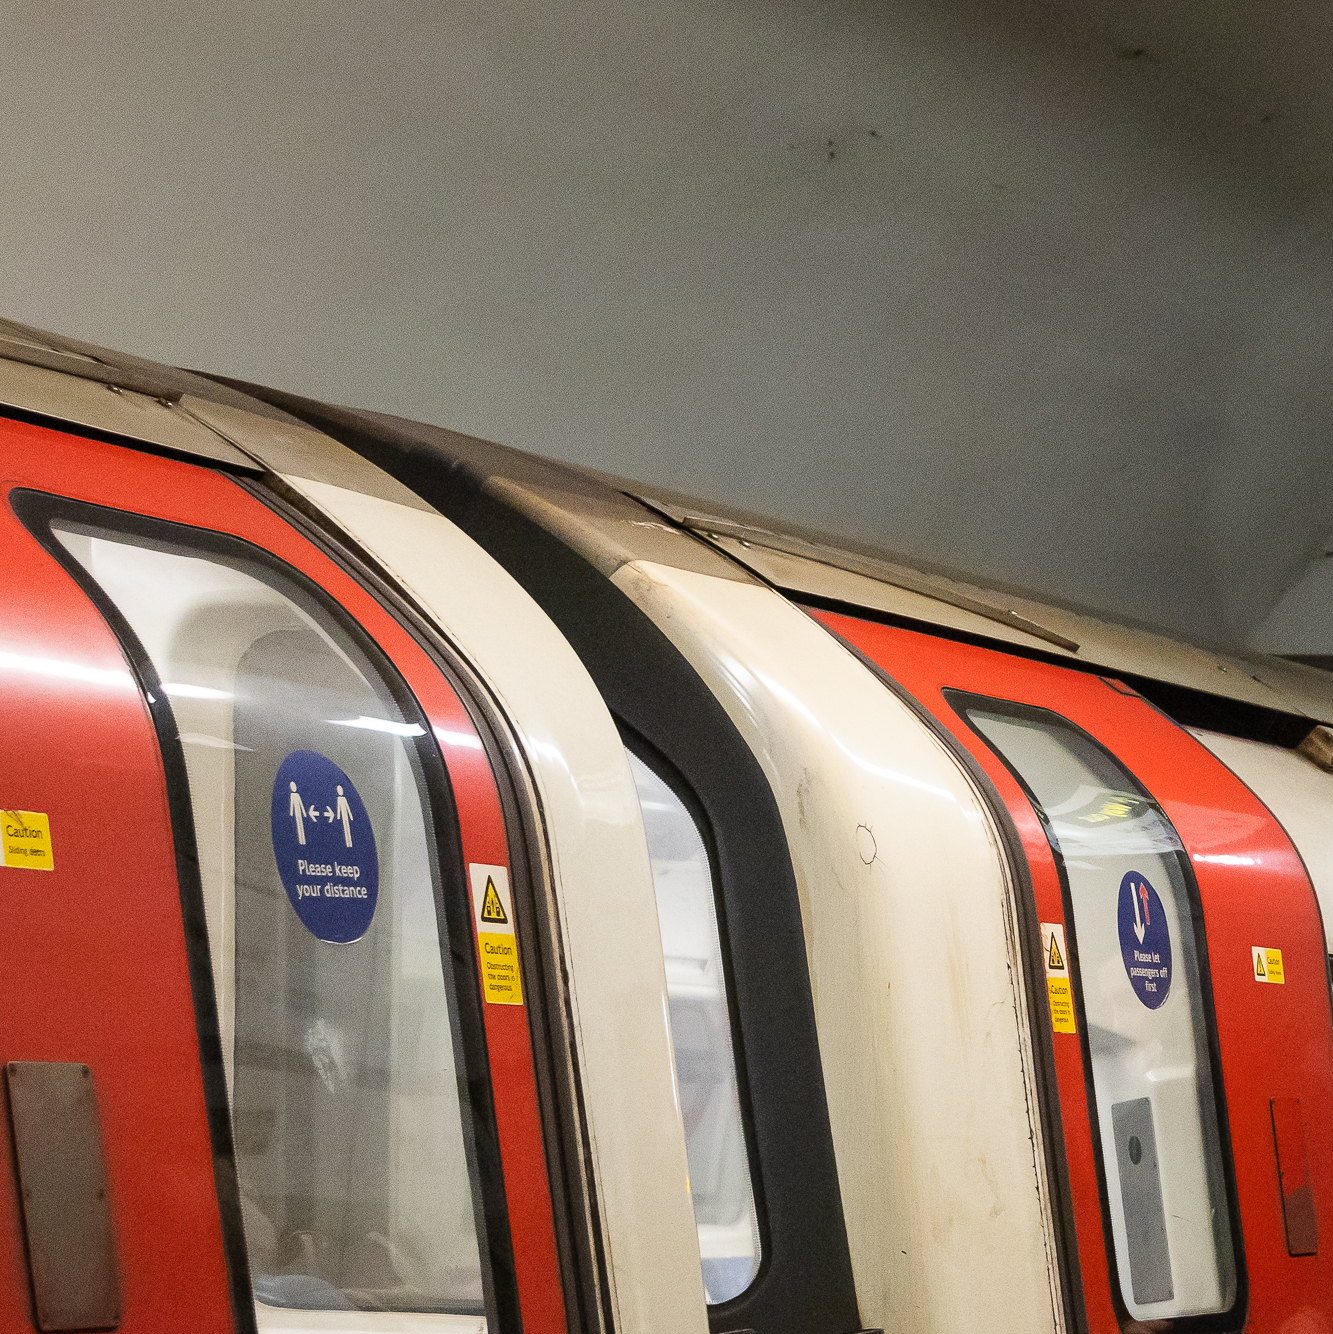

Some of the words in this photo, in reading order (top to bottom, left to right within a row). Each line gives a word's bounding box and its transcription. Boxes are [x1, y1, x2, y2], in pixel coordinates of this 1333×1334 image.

[6, 824, 43, 839] Caution
[298, 859, 332, 877] Please
[334, 861, 361, 881] keep
[296, 882, 322, 900] your
[324, 880, 368, 899] distance
[484, 942, 512, 956] Caution
[1134, 949, 1152, 962] Please
[1152, 951, 1161, 963] let
[1130, 967, 1159, 979] passengers
[1160, 966, 1168, 978] off
[1145, 980, 1157, 992] first
